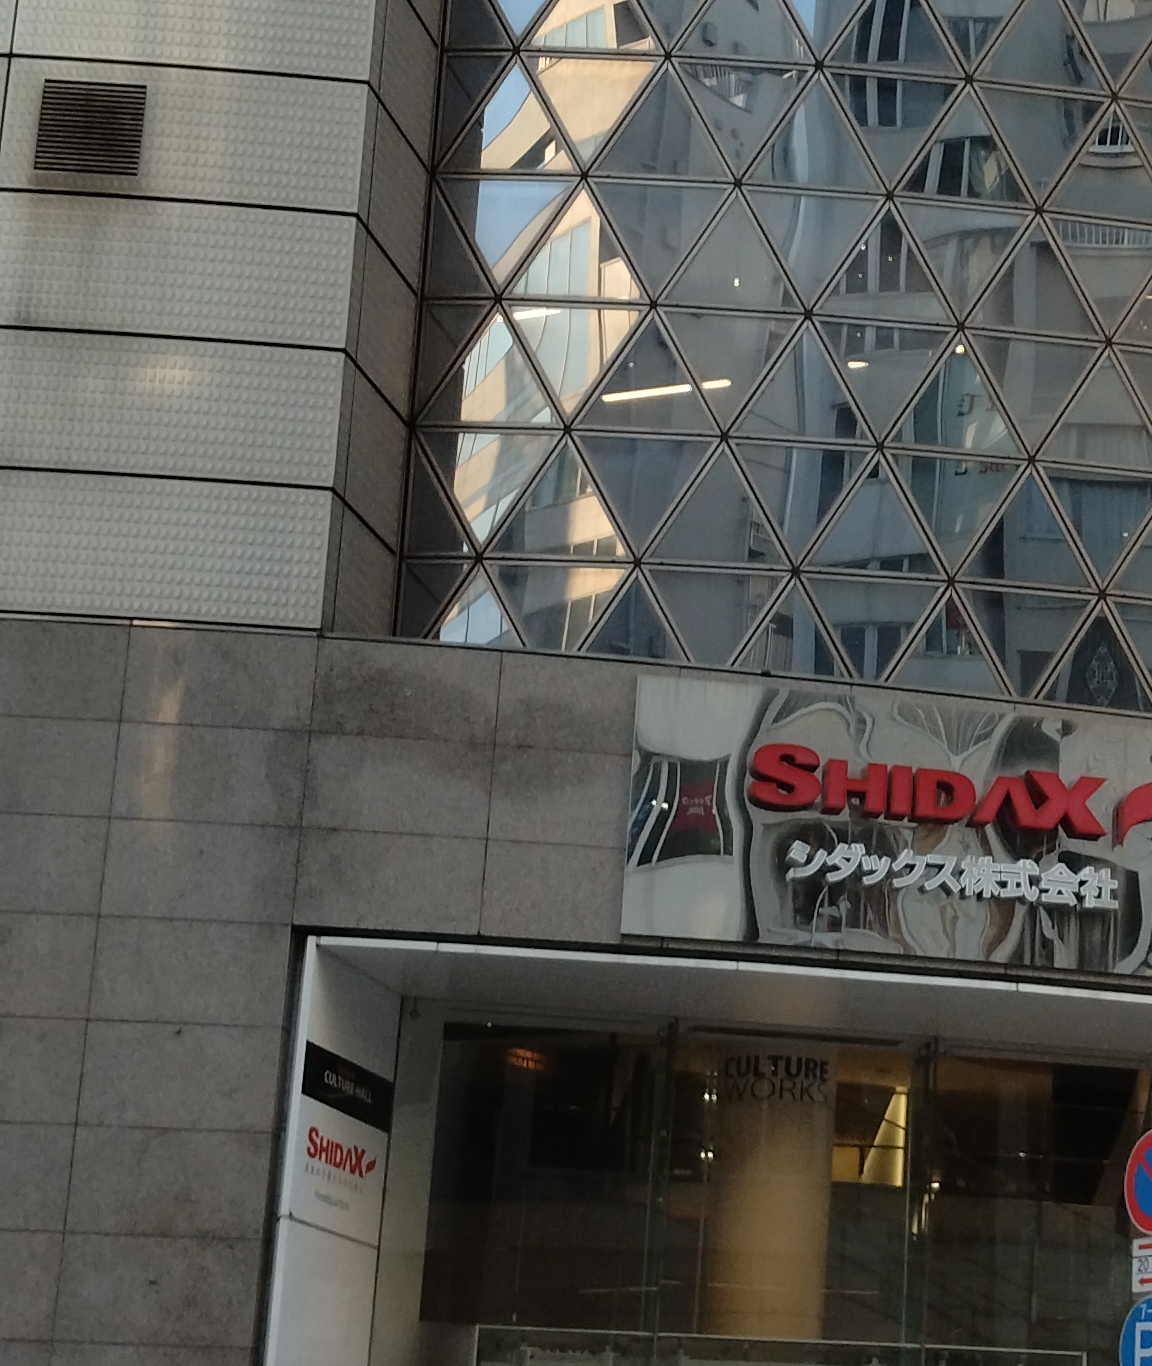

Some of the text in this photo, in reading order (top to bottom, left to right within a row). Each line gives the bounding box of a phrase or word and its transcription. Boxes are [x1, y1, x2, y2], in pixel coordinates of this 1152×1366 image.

[747, 742, 1108, 840] SHIDAX
[784, 838, 1119, 910] シダックス株式会社
[725, 1055, 829, 1082] CULTURE
[323, 1069, 356, 1097] CULTURE
[725, 1077, 828, 1103] WORKS
[306, 1125, 366, 1178] SHIDAX
[1137, 1256, 1149, 1273] 20
